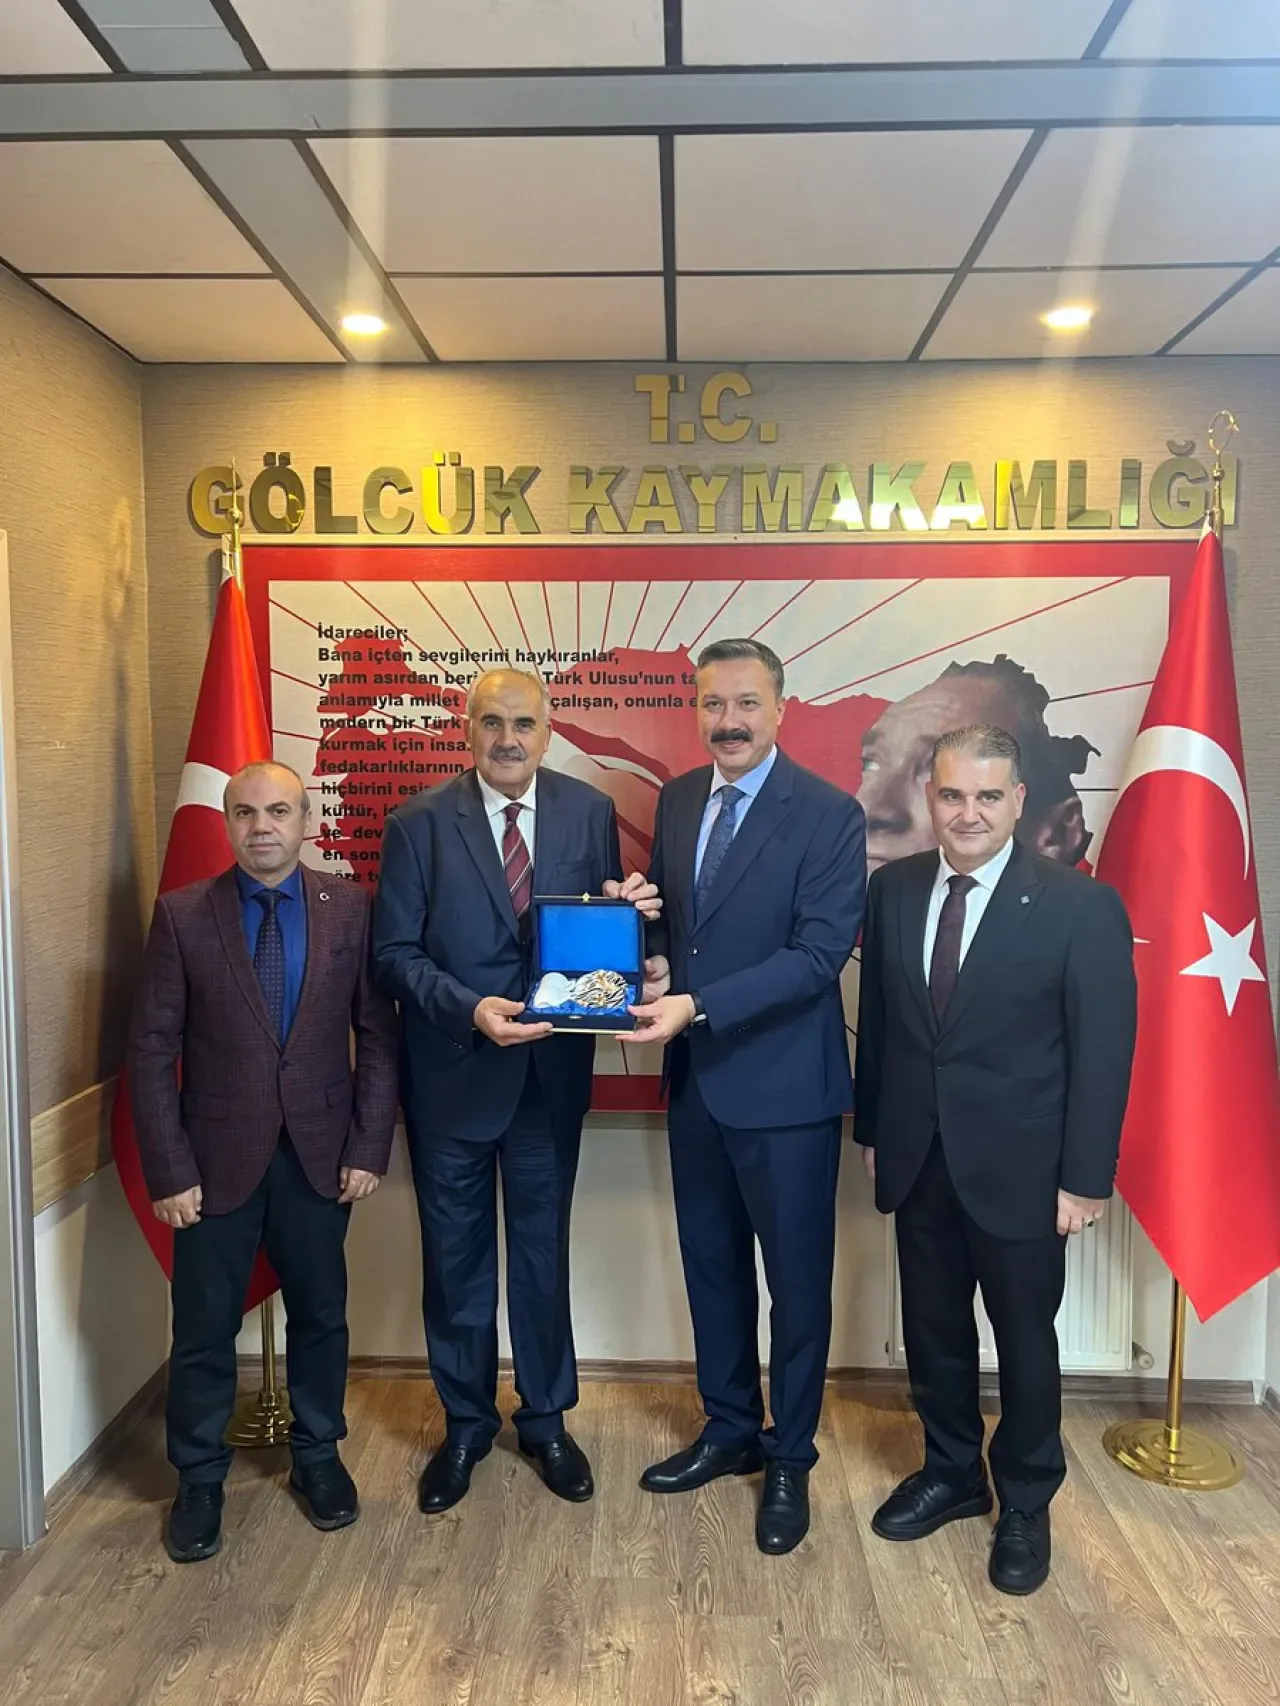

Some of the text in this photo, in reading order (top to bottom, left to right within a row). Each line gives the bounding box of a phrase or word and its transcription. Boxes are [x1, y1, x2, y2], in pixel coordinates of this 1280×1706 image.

[634, 371, 777, 443] T.C.
[189, 440, 1237, 535] GÖLCÜK KAYMAKAMLIĞI
[318, 621, 408, 641] İdareciler;
[318, 648, 619, 665] Bana içten sevgilerini haykıranlar,
[318, 673, 367, 686] yarım
[373, 672, 439, 684] asırdan
[444, 671, 478, 684] beri
[542, 671, 583, 685] Türk
[319, 694, 404, 709] anlamıyla
[410, 694, 460, 707] millet
[551, 695, 618, 710] çalışan,
[625, 694, 683, 707] onunla
[319, 715, 461, 729] modern bir Türk
[319, 737, 471, 753] kurmak için insa
[319, 760, 464, 774] fedakarlıklarının
[321, 782, 392, 797] hiçbirini
[322, 804, 377, 819] kültür,
[322, 828, 342, 840] ve
[322, 849, 380, 861] en son
[332, 869, 361, 883] öre
